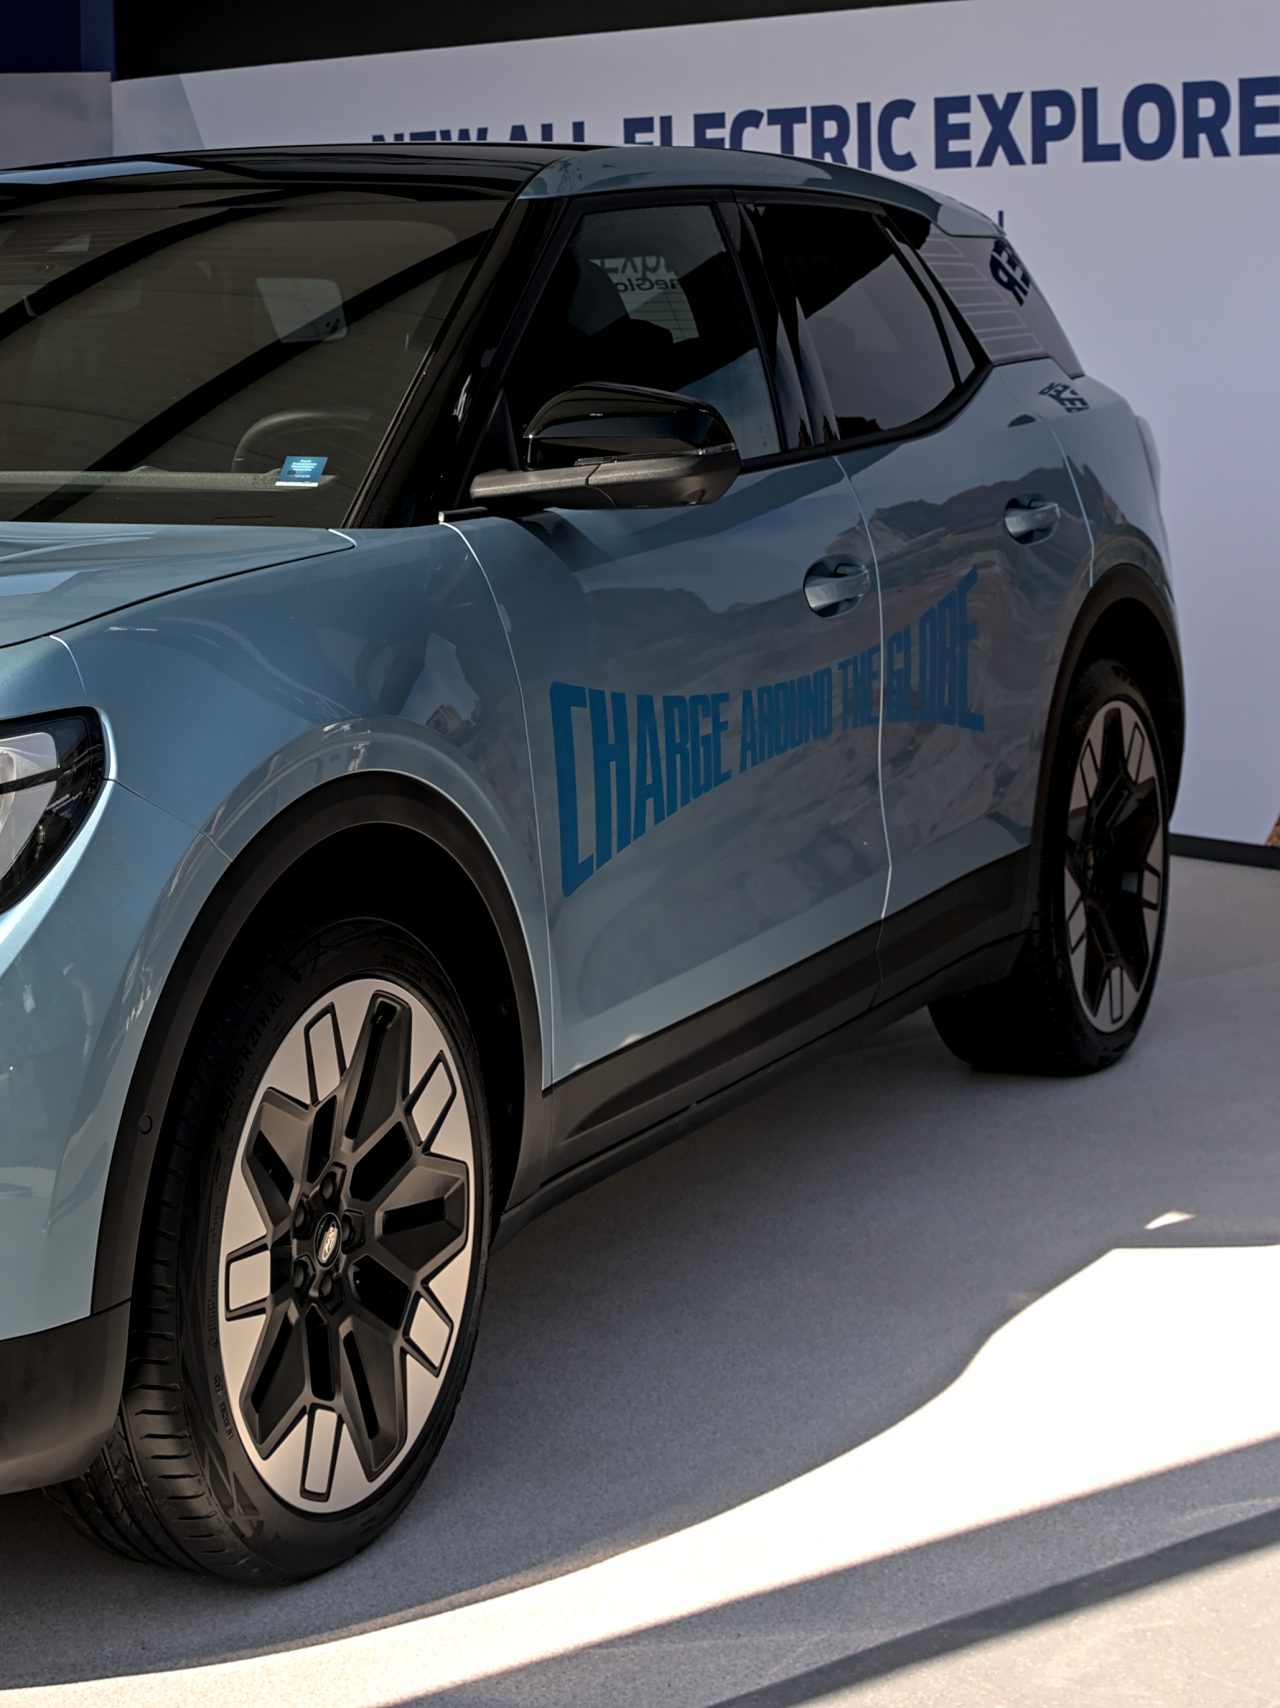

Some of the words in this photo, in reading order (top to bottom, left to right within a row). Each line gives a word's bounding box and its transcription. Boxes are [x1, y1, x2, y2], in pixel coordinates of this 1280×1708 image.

[934, 75, 1280, 170] EXPLORE
[549, 681, 733, 898] CHARGE
[738, 667, 834, 775] AROUND
[837, 642, 882, 732] THE
[886, 565, 986, 732] GLOBE
